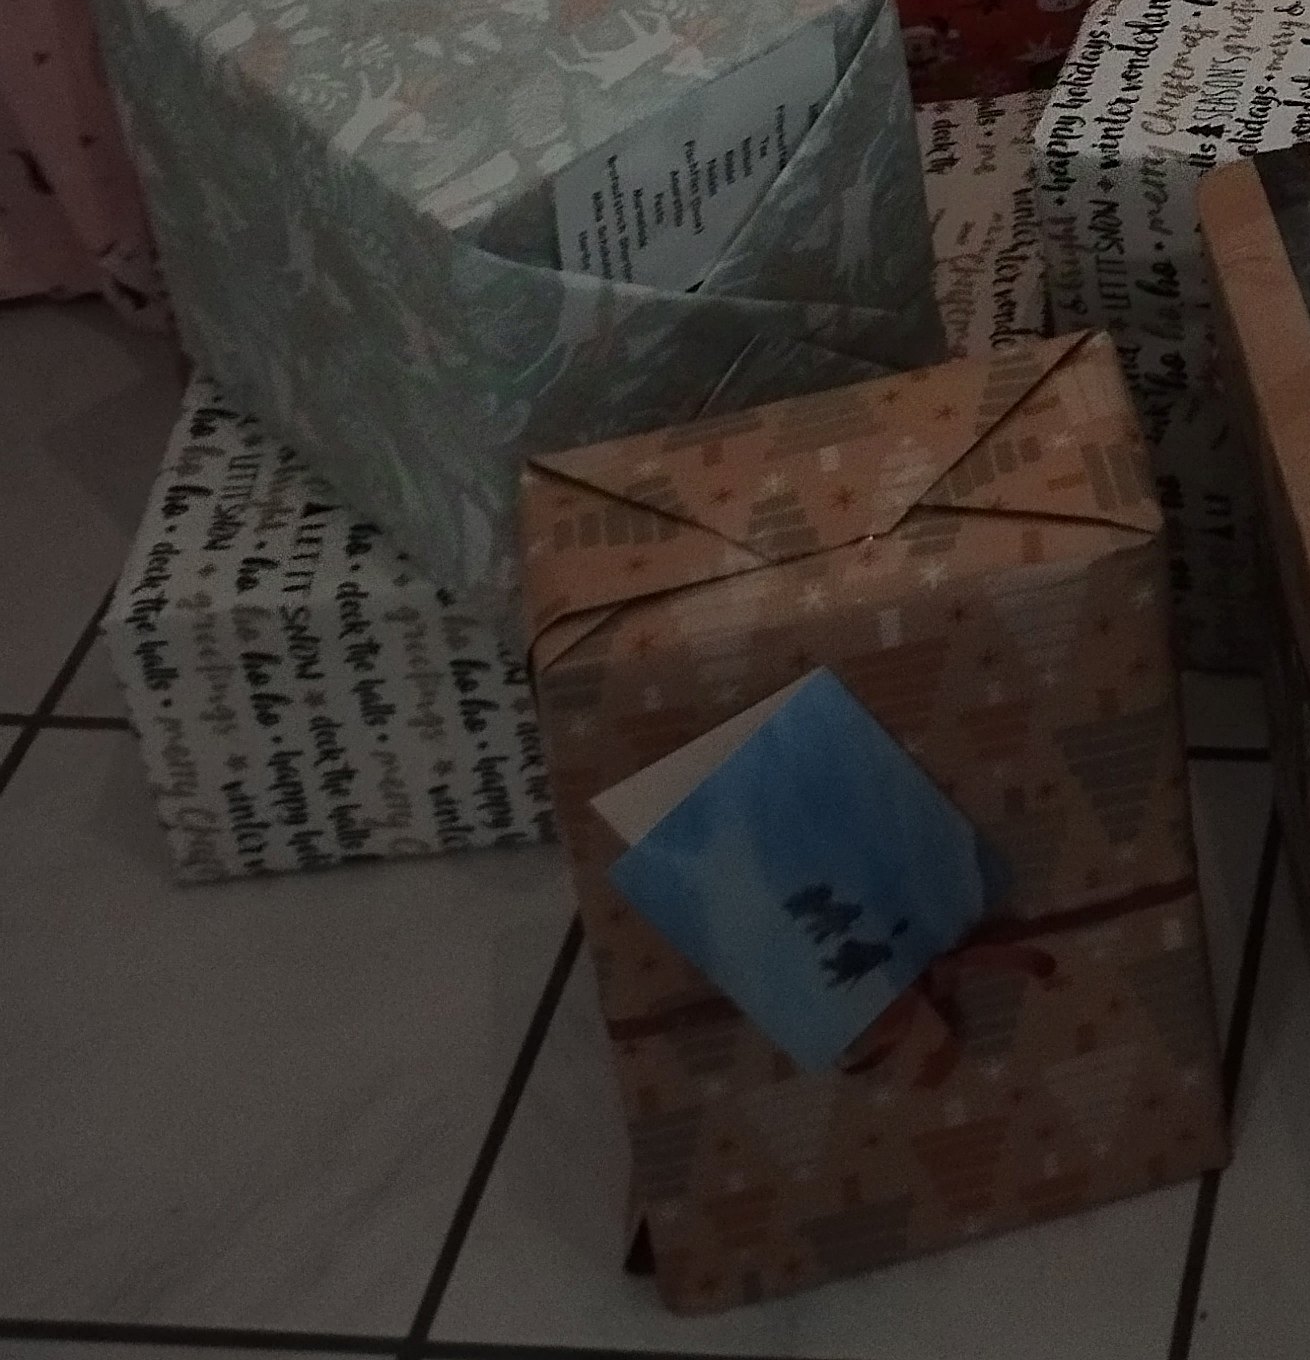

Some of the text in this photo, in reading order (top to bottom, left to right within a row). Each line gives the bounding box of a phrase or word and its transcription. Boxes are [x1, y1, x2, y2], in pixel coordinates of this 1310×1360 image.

[1054, 29, 1116, 109] holidays
[1042, 116, 1086, 192] happy
[1092, 94, 1139, 169] winter
